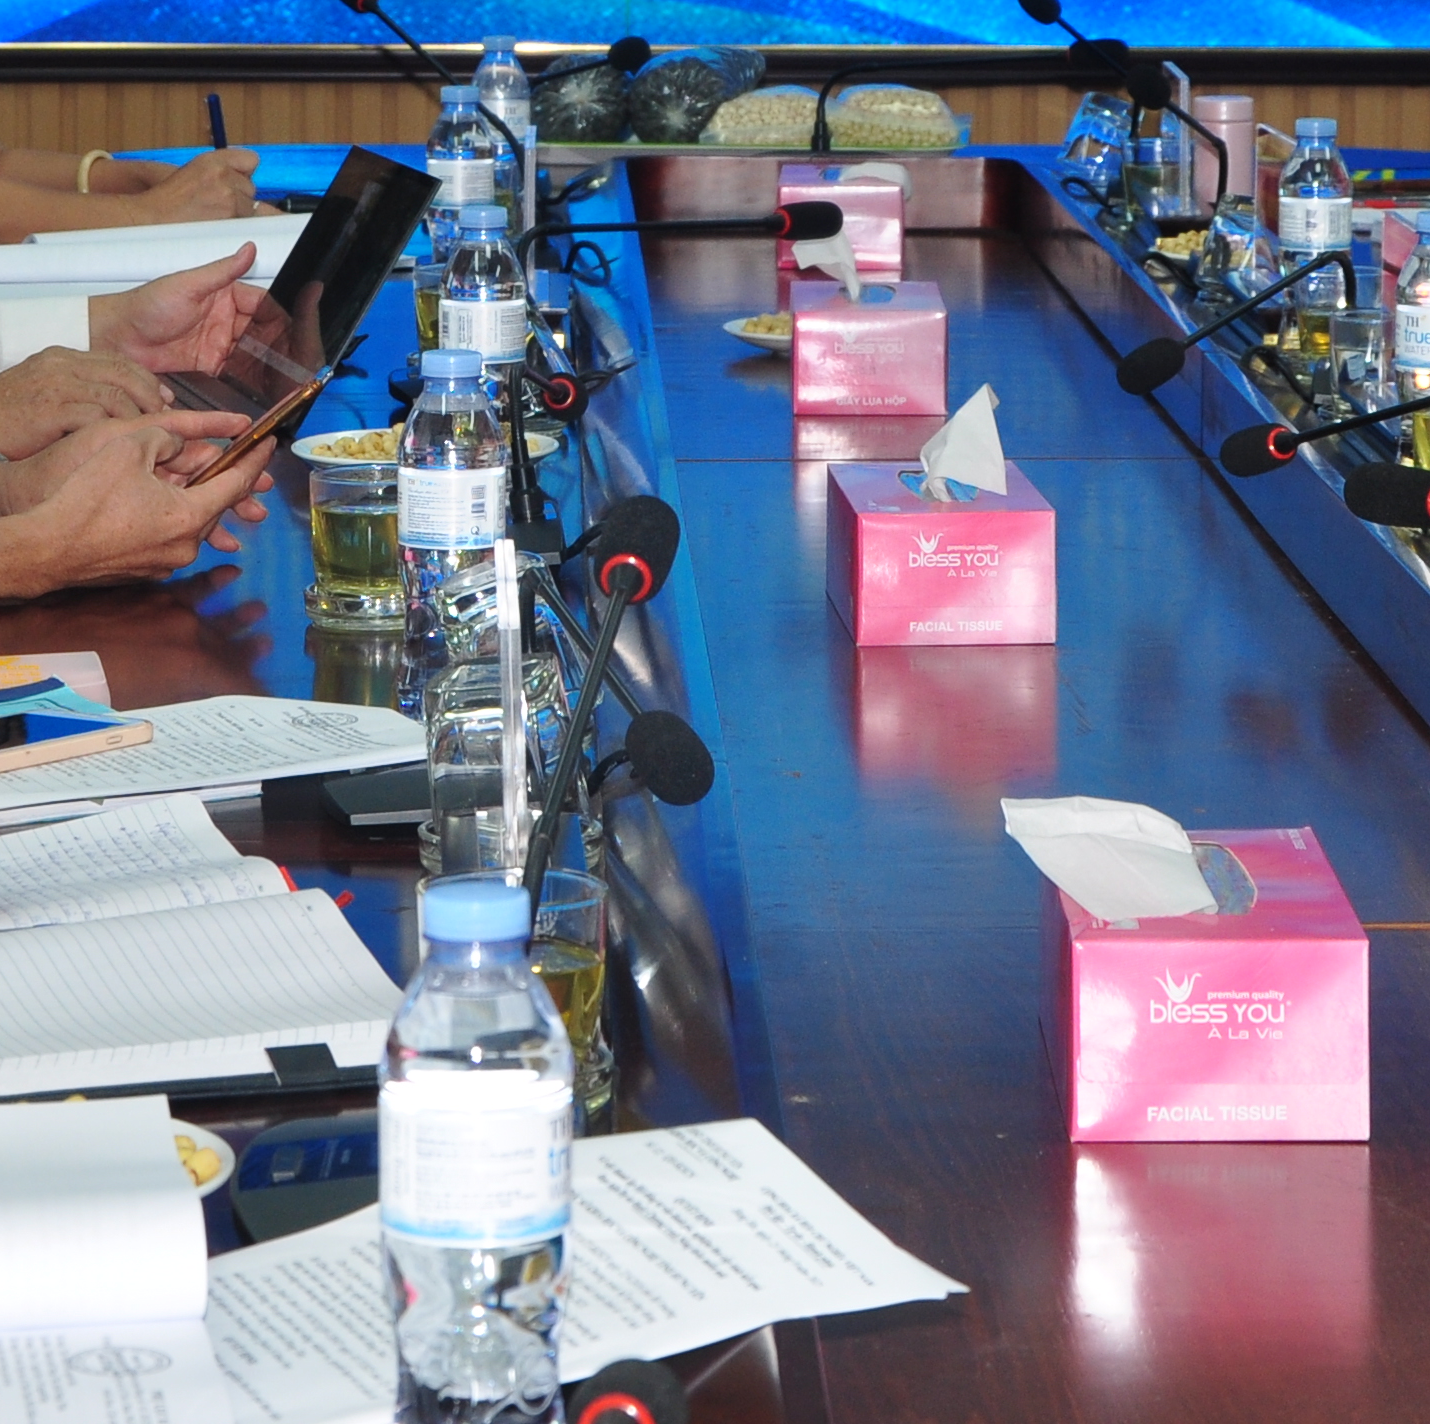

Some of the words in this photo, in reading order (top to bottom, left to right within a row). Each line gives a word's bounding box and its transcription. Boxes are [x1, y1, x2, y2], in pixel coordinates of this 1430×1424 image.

[909, 551, 961, 567] bless
[909, 621, 954, 632] FACIAL
[957, 620, 1003, 631] TISSUE
[1207, 991, 1249, 1001] premium
[1252, 990, 1284, 1001] quality
[1150, 999, 1228, 1023] bless
[1229, 1028, 1249, 1039] La
[1256, 1028, 1283, 1039] Vie
[1147, 1106, 1214, 1122] FACIAL
[1220, 1105, 1288, 1121] TISSUE
